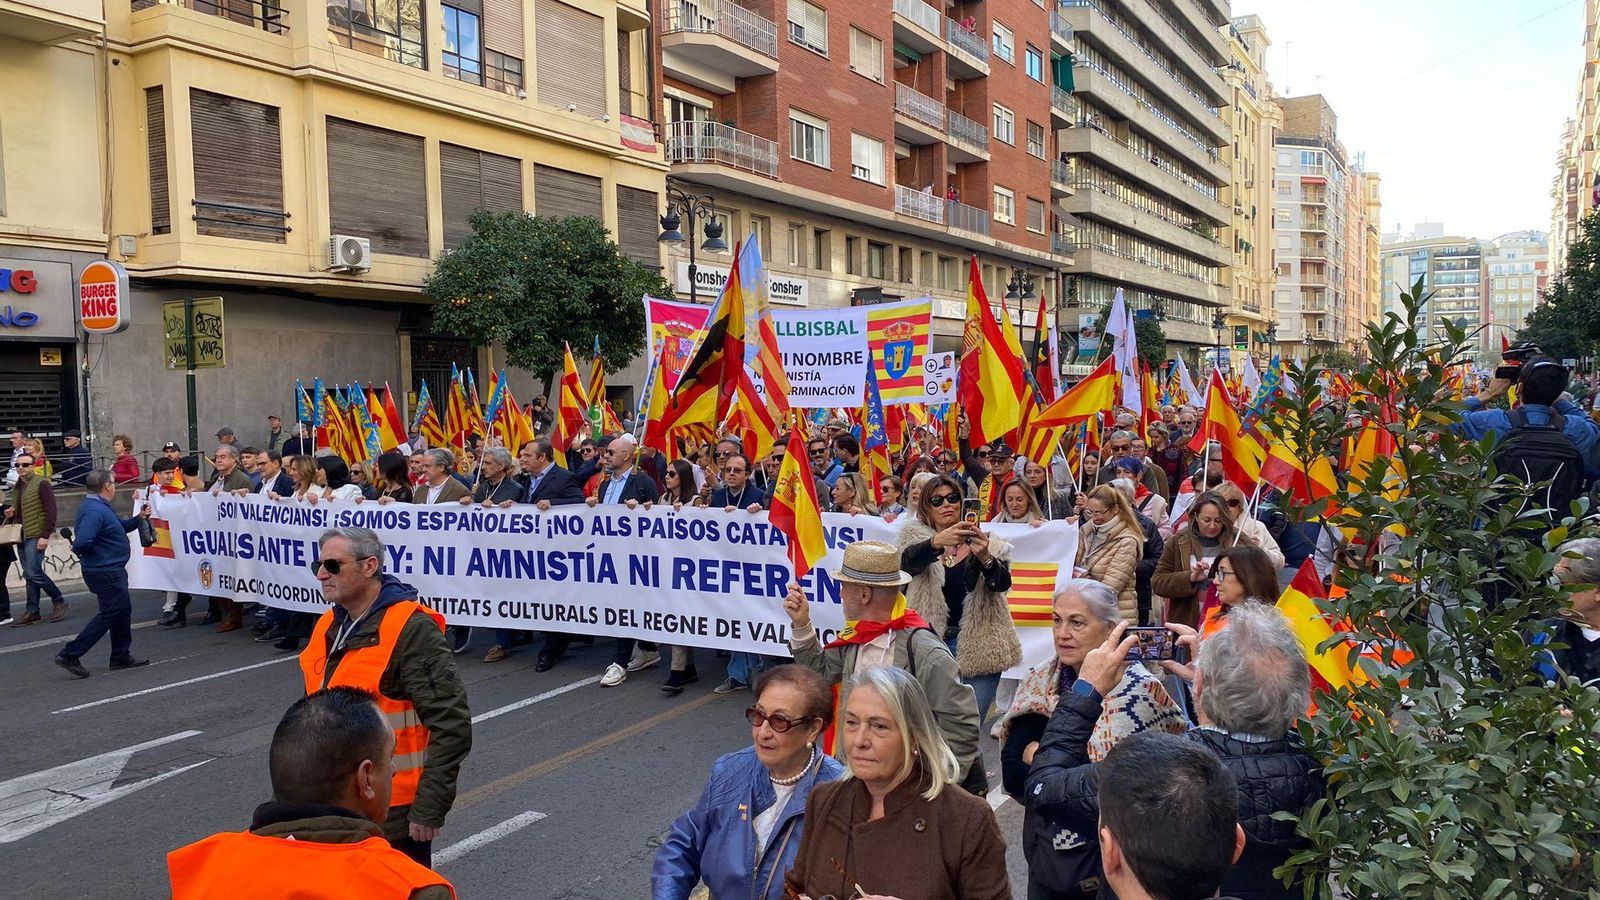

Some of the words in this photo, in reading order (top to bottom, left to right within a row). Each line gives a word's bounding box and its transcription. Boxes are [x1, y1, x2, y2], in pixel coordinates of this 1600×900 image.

[694, 270, 727, 286] onshe
[81, 284, 116, 298] BURGER
[770, 278, 803, 296] onsher
[81, 298, 117, 317] KING
[773, 320, 859, 336] LLBISBAL
[779, 352, 788, 366] I
[793, 351, 863, 366] NOMBRE
[786, 370, 821, 381] NISTÍA
[218, 502, 237, 521] ¡SO
[239, 503, 328, 527] VALENCIANS!
[334, 509, 411, 530] ¡SOMOS
[418, 508, 540, 534] ESPAÑOLES!
[547, 515, 584, 539] ¡NO
[591, 515, 632, 537] ALS
[638, 512, 720, 542] PAÏSOS
[726, 521, 863, 549] CATANS!
[258, 536, 307, 567] ANTE
[423, 546, 456, 575] NI
[465, 542, 619, 584] AMNISTÍA
[629, 554, 660, 588] NI
[672, 557, 841, 604] REFEREN
[268, 582, 335, 605] COORDIN
[419, 596, 491, 617] NTITATS
[498, 600, 598, 624] CULTURALS
[604, 607, 638, 628] DEL
[643, 611, 707, 636] REGNE
[716, 618, 741, 640] DE
